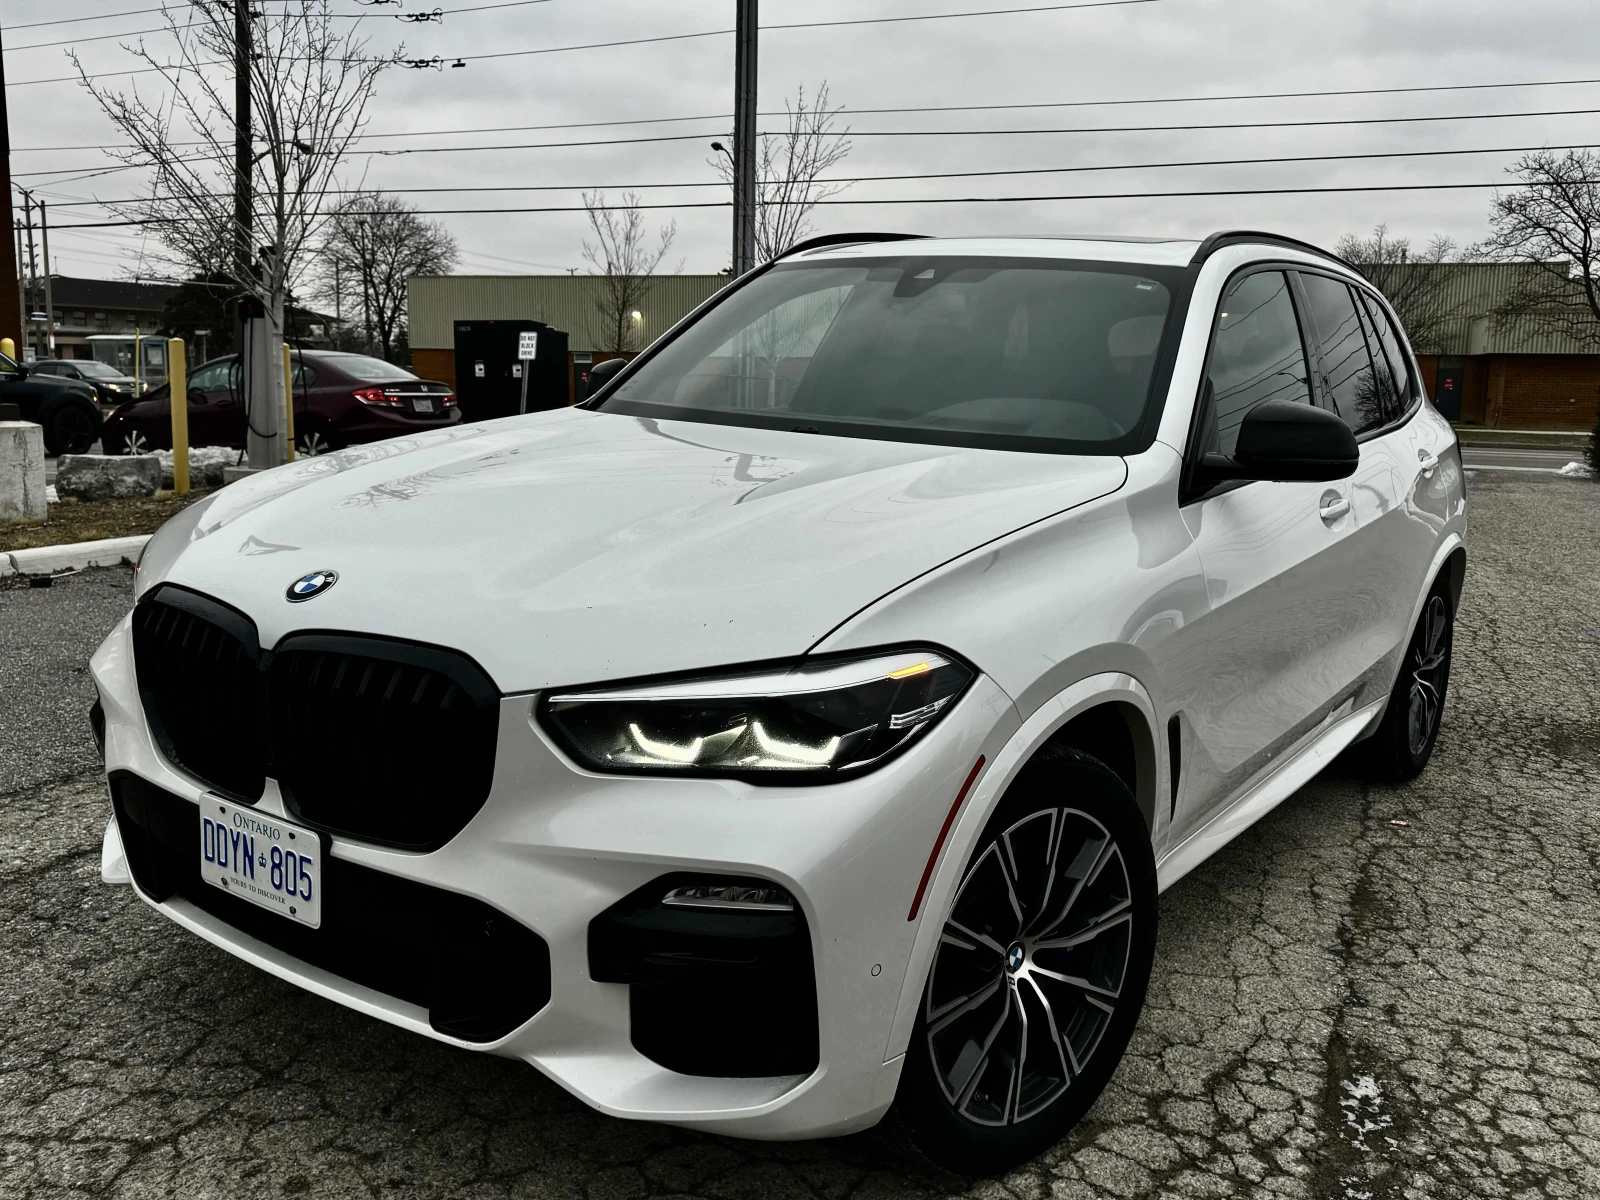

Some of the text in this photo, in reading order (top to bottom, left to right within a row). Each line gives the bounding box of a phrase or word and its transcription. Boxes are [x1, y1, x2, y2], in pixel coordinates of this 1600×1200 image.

[233, 812, 280, 840] ONTARIO
[204, 818, 313, 902] DDYN 805
[230, 876, 286, 904] YOURS TO DISCOVER
